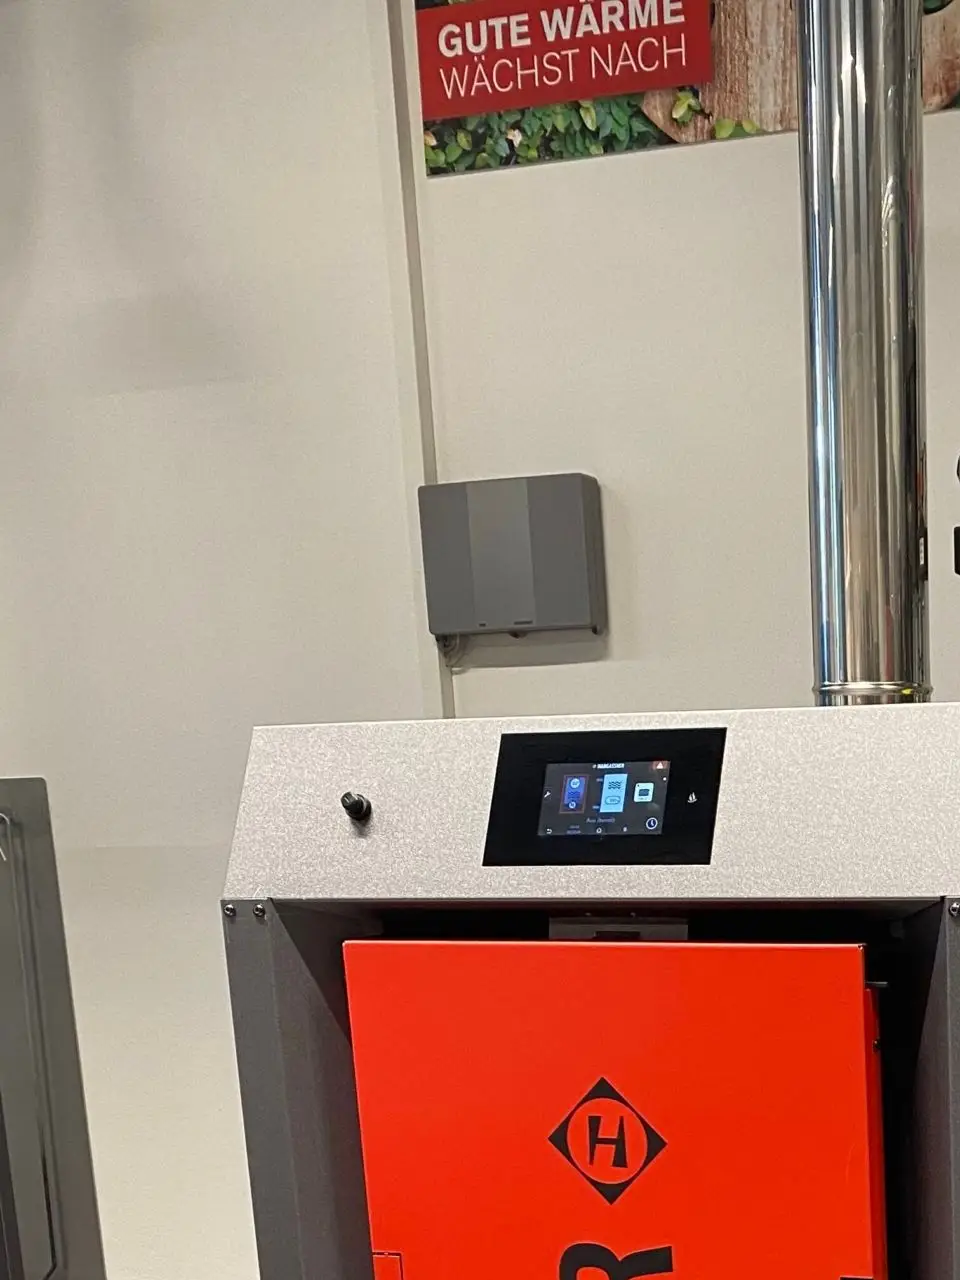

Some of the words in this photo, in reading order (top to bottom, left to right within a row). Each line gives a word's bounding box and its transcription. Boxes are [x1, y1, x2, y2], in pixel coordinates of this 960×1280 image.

[438, 13, 532, 58] GUTE
[540, 0, 686, 43] WÄRME
[440, 49, 580, 100] WÄCHST
[591, 33, 687, 79] NACH
